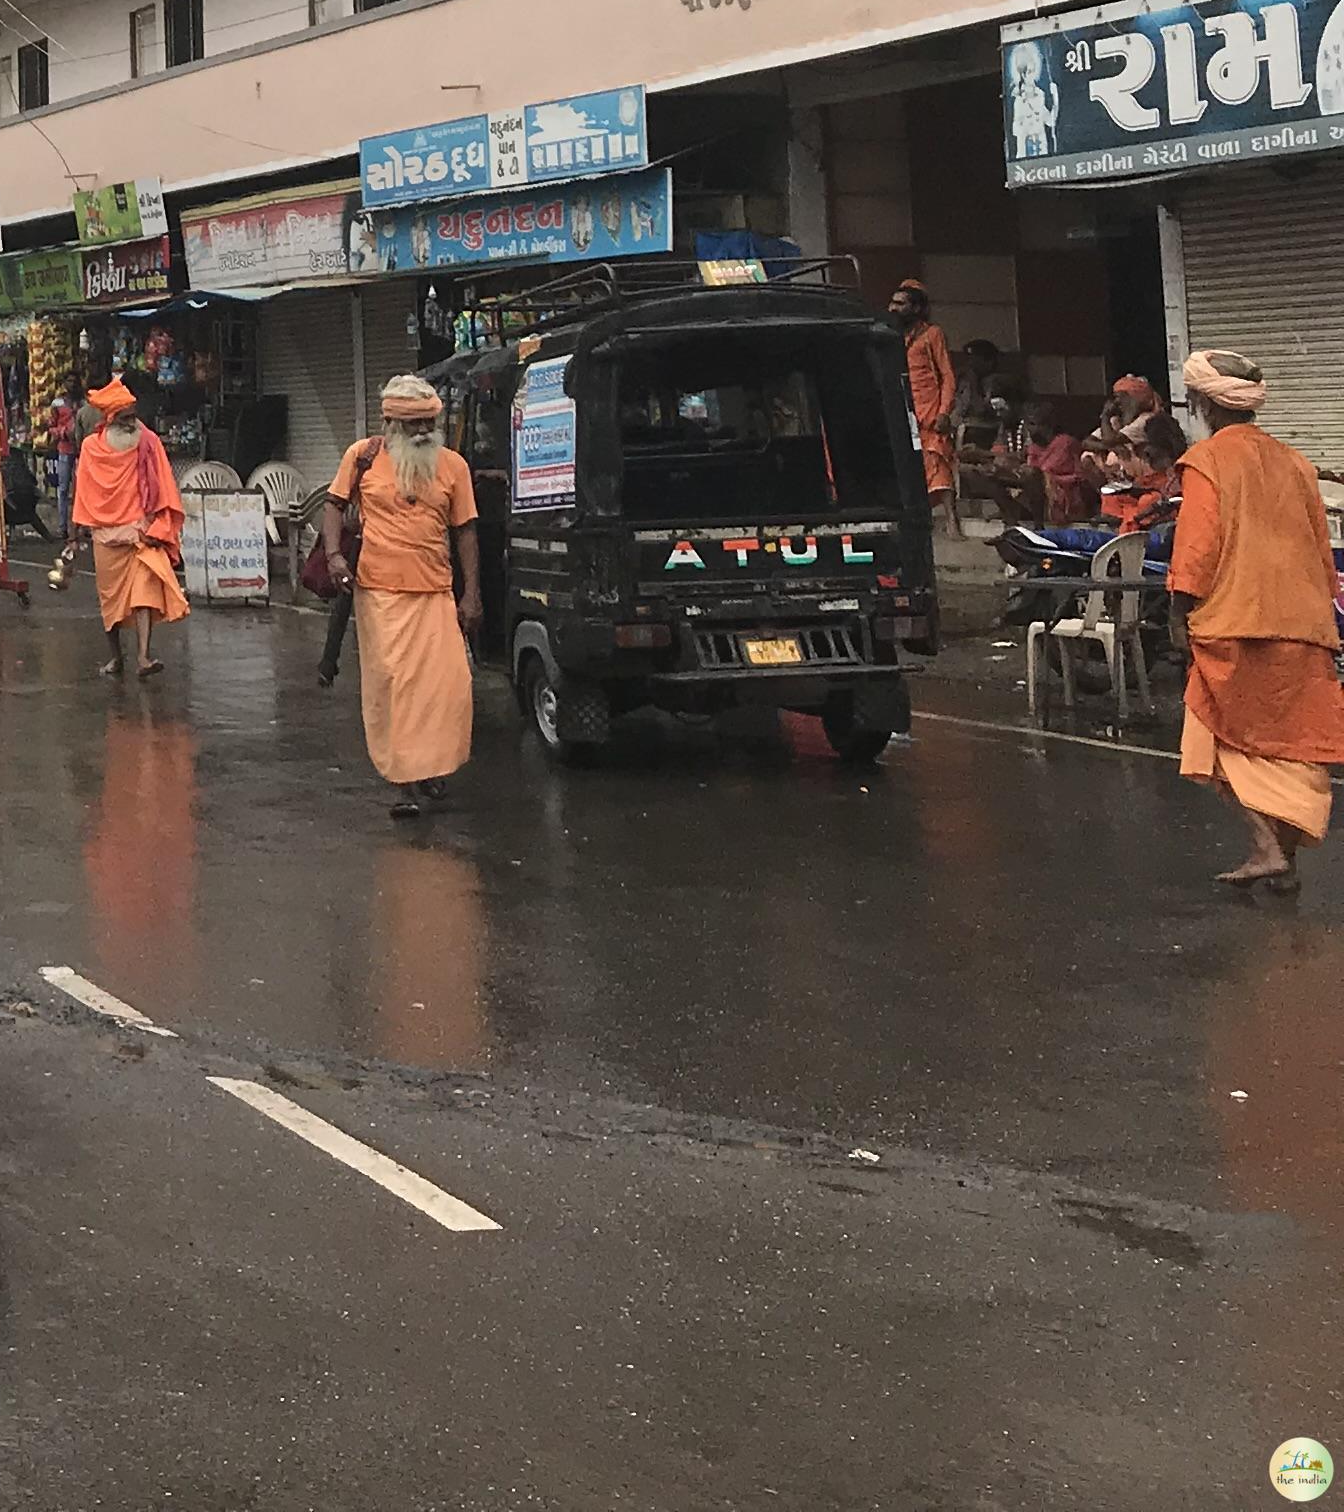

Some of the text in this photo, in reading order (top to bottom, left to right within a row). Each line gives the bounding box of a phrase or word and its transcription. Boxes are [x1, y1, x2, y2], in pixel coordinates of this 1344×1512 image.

[1064, 1, 1313, 132] શ્રી રામ
[367, 140, 486, 191] સોરઠ દૂધ
[498, 140, 516, 155] પાન
[1075, 153, 1134, 178] દાગીના
[1142, 142, 1188, 167] ગેરંટી
[1197, 138, 1241, 158] વાળા
[1250, 127, 1319, 152] દાગીના
[664, 534, 874, 570] ATUL
